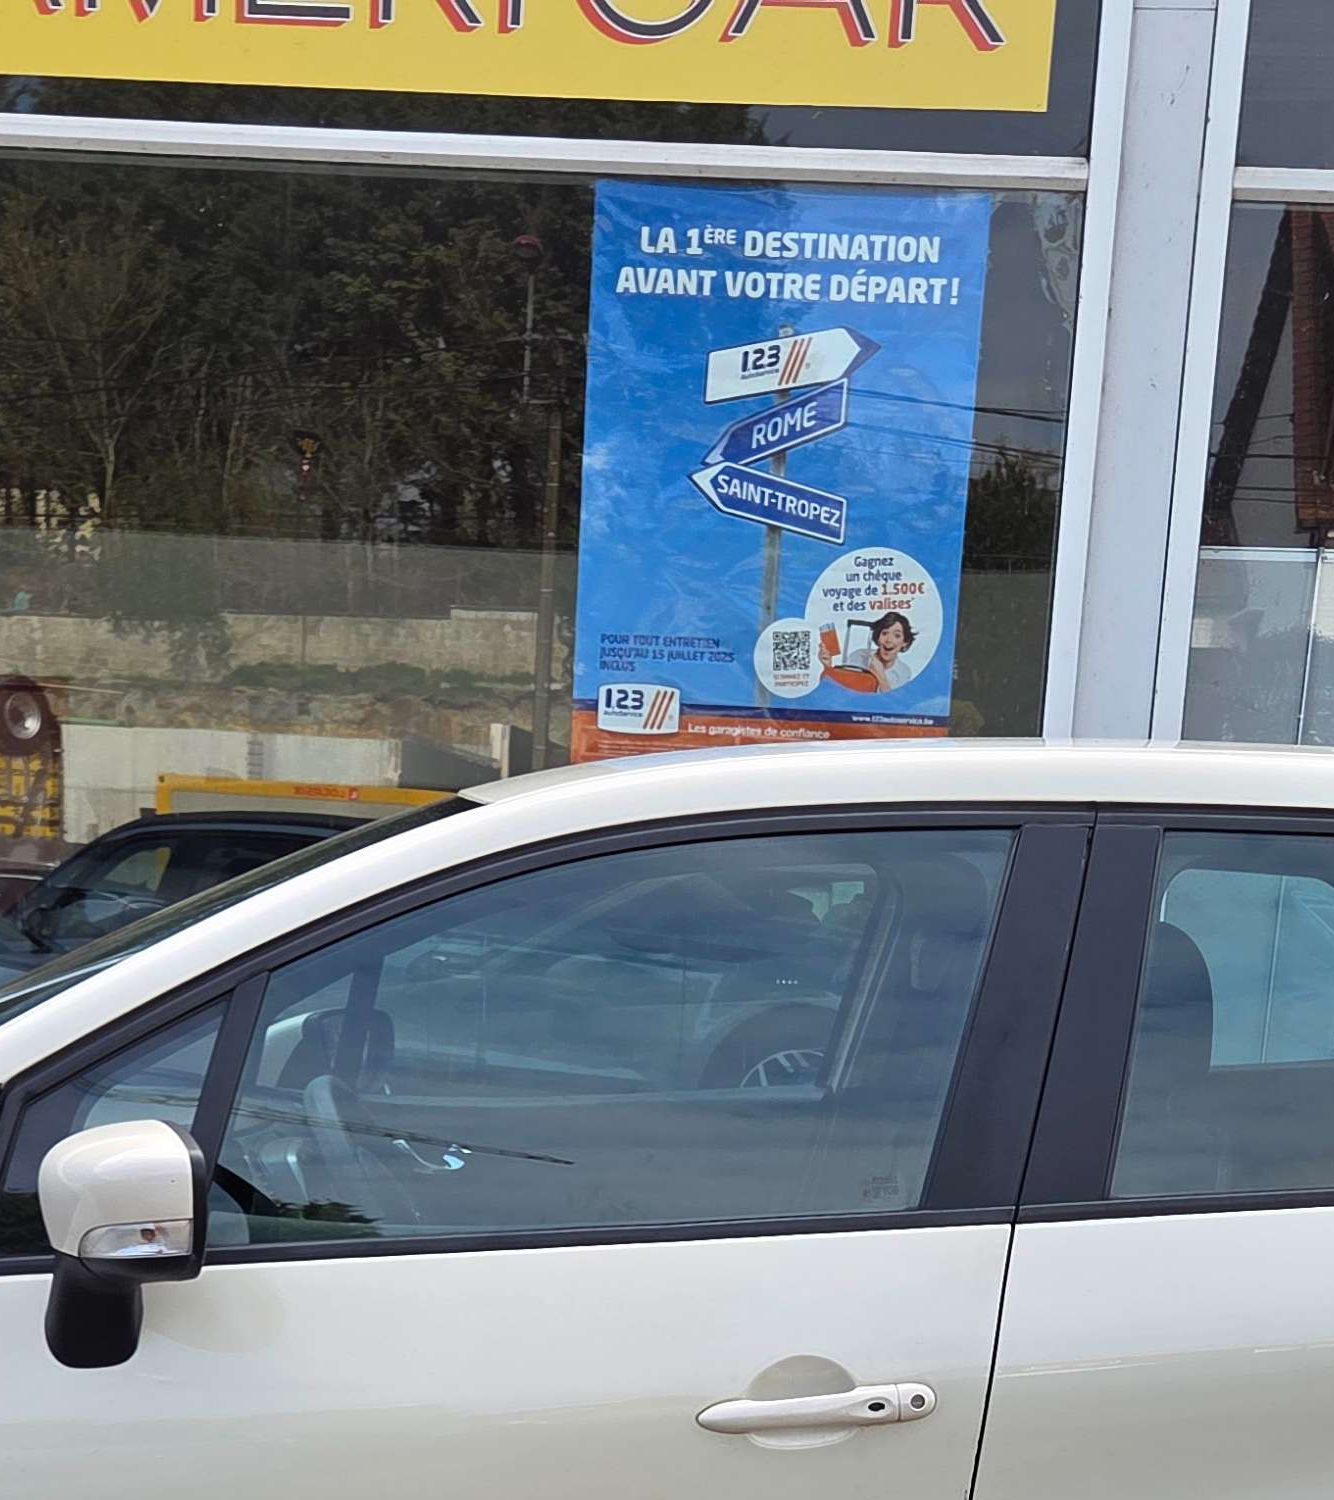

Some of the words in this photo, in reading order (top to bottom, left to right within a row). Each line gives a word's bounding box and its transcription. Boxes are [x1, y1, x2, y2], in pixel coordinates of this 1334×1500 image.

[640, 226, 676, 254] LA
[686, 224, 737, 255] 1ÈRE
[744, 230, 941, 264] DESTINATION
[616, 266, 717, 296] AVANT
[724, 271, 821, 301] VOTRE
[751, 401, 818, 449] ROME
[717, 474, 841, 527] SAINT-TROPEZ
[854, 556, 894, 570] Gagnez
[846, 573, 860, 582] un
[863, 569, 902, 583] chèque
[822, 586, 862, 599] voyage
[864, 585, 878, 596] de
[833, 601, 844, 612] et
[847, 600, 866, 612] des
[600, 633, 629, 645] POUR
[632, 634, 661, 646] TOUT
[687, 722, 706, 734] Les
[764, 726, 778, 737] de
